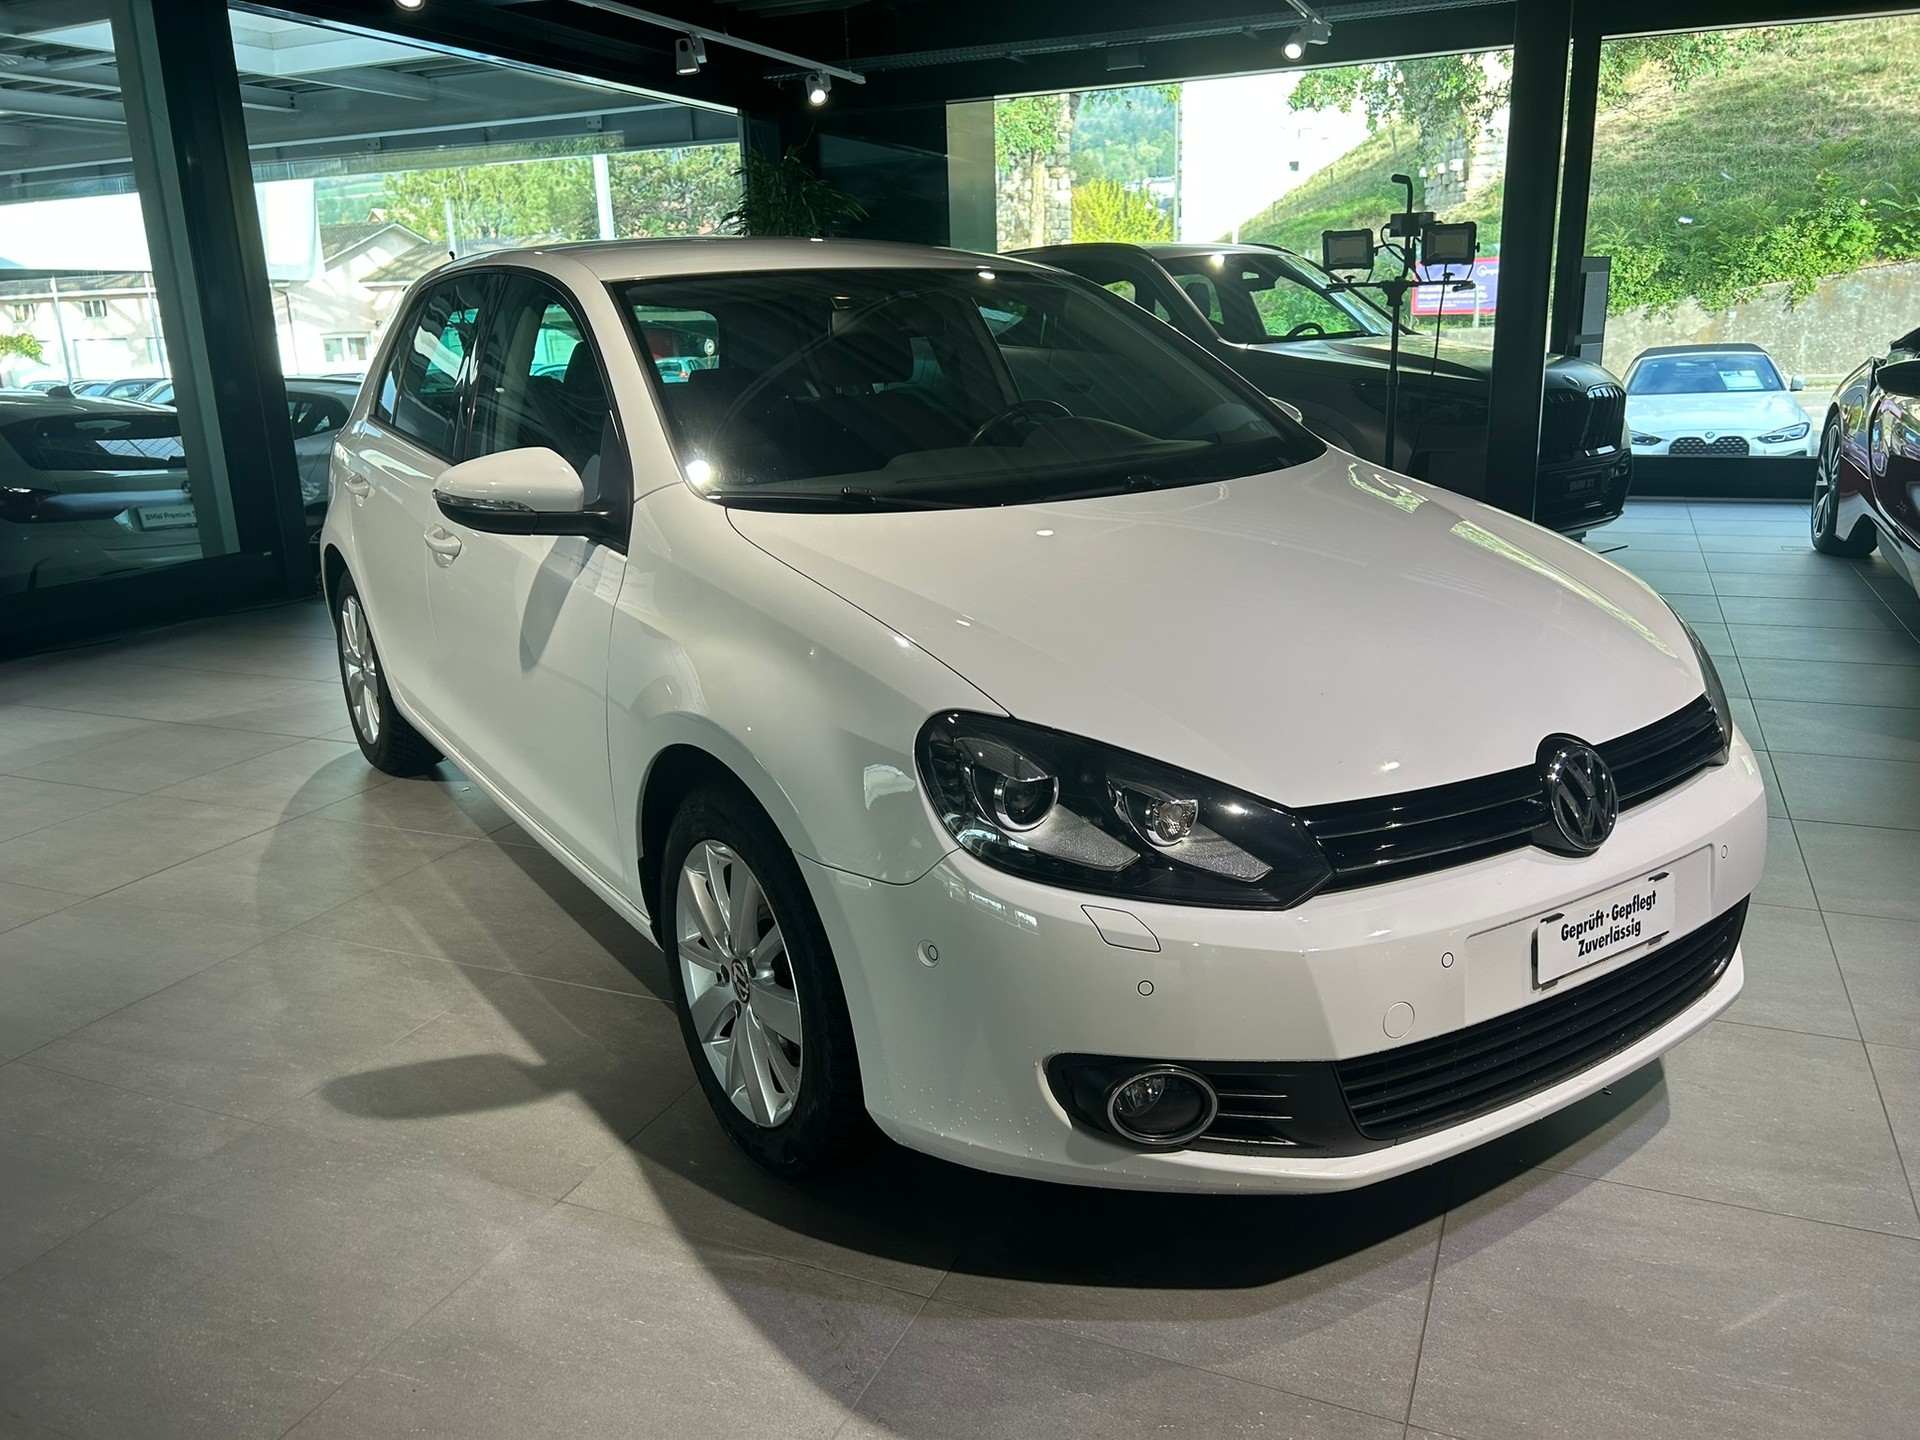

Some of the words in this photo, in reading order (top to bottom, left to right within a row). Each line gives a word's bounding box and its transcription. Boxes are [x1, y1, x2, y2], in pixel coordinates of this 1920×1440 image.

[1569, 479, 1586, 491] BMW
[145, 512, 163, 521] BMW
[164, 511, 191, 519] Premium
[1561, 909, 1605, 941] Geprüft
[1611, 889, 1657, 921] Gepflegt
[1577, 918, 1641, 957] Zuverlässig
